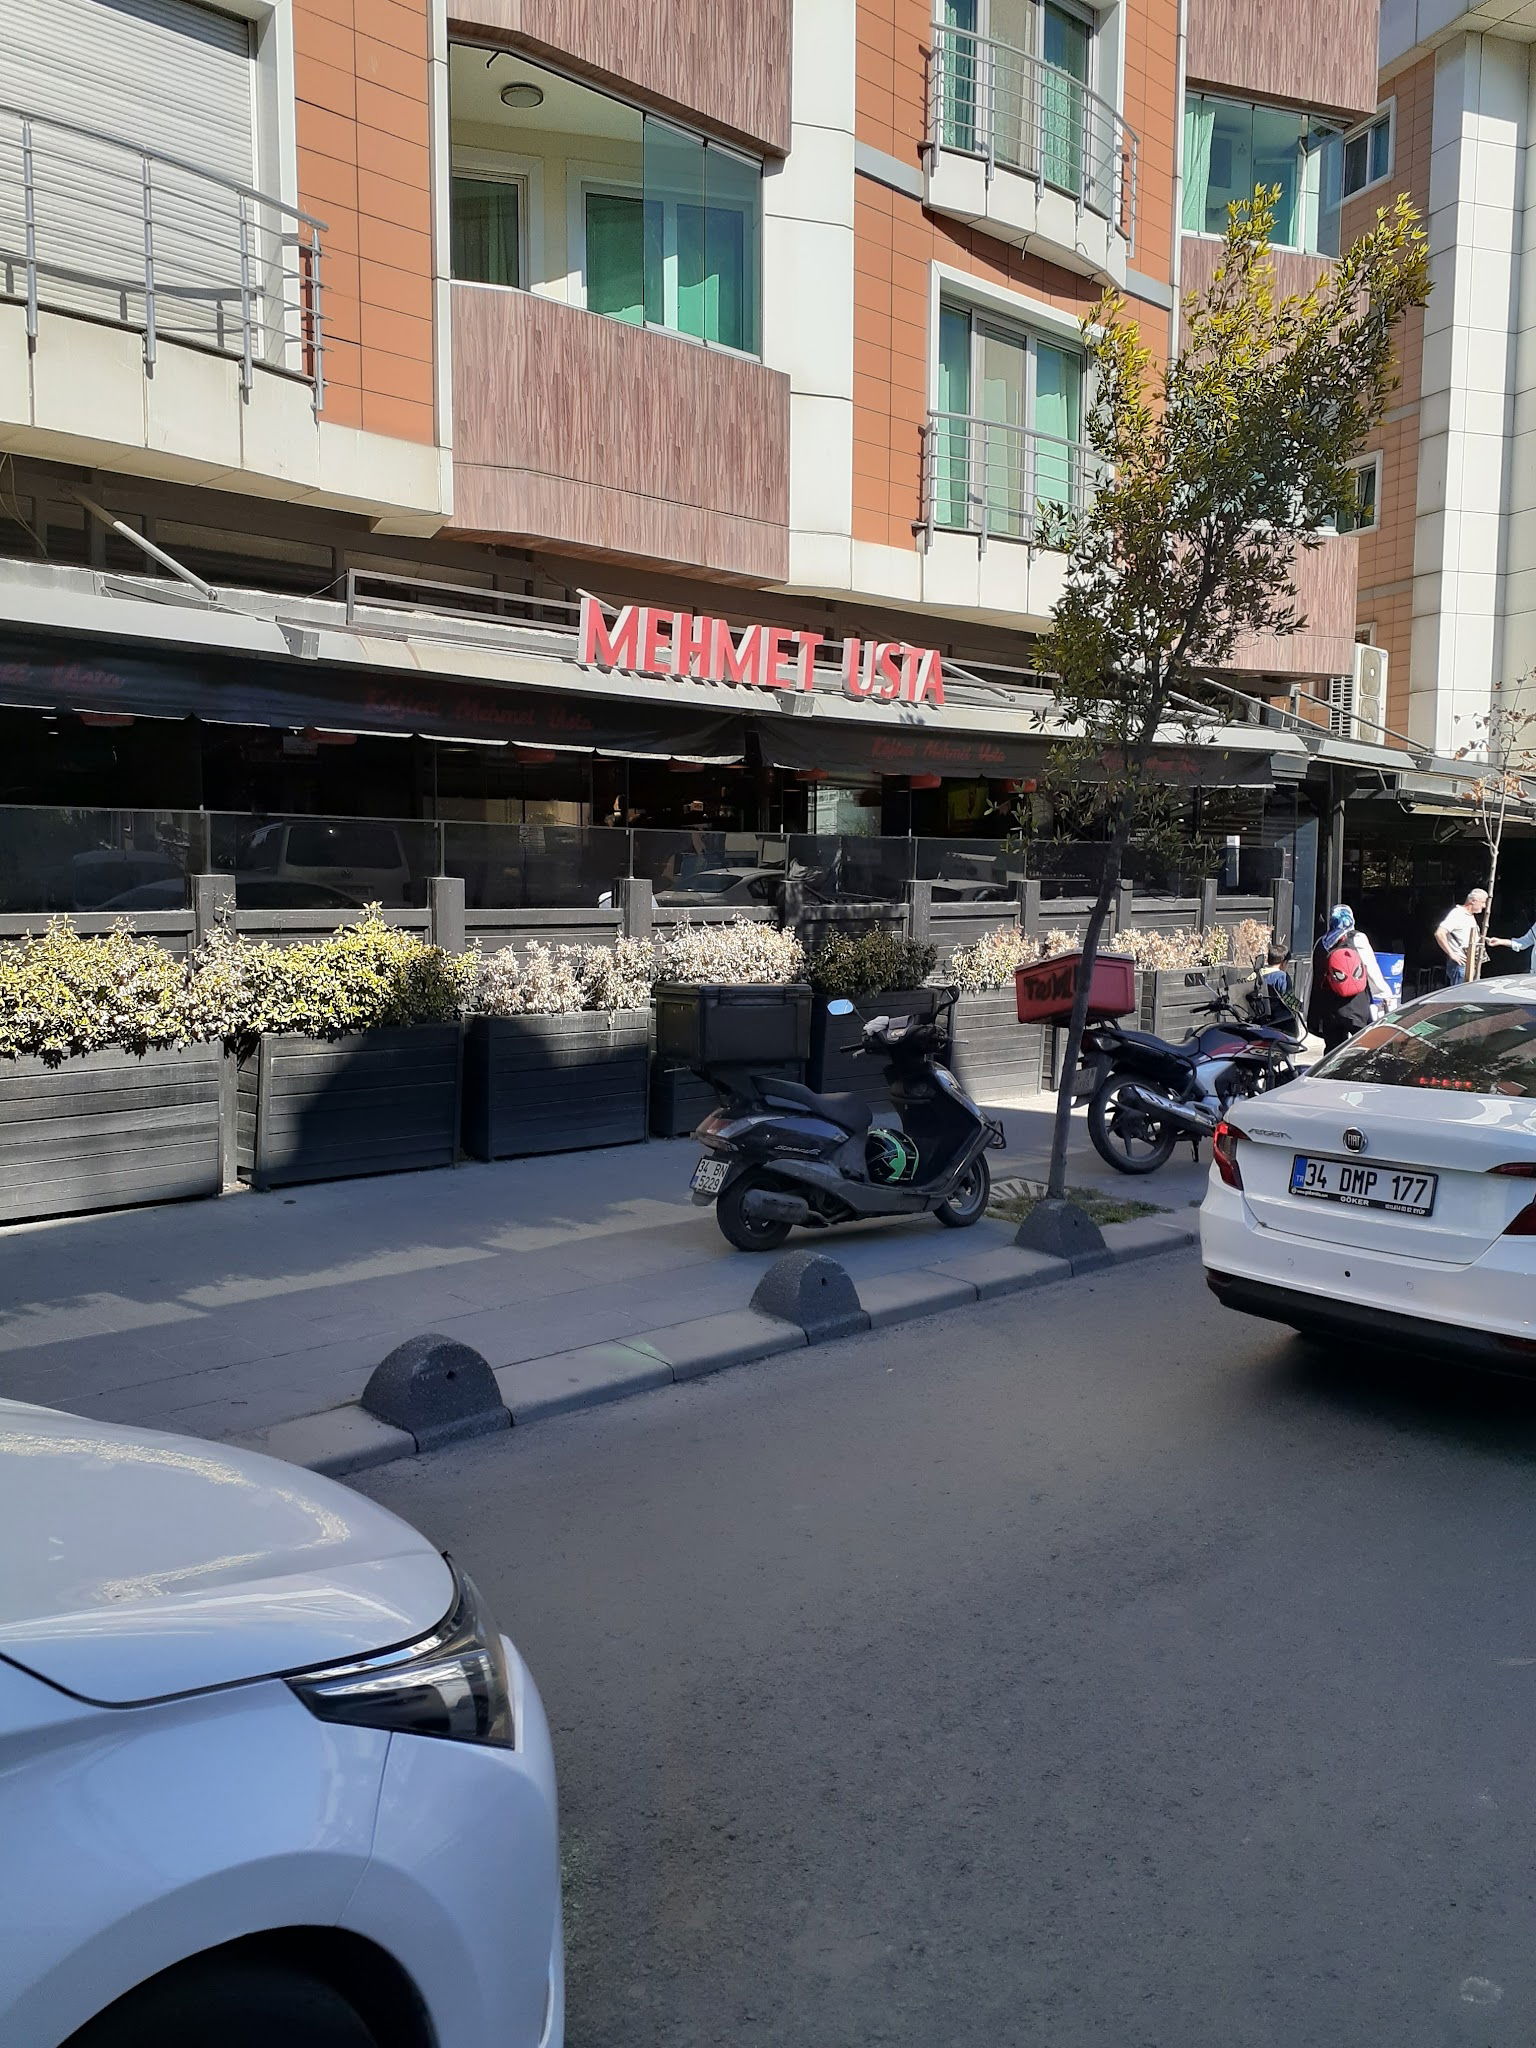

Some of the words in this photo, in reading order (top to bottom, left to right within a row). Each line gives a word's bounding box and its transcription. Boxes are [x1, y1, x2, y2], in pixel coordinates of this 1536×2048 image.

[579, 597, 824, 691] MEHMET
[842, 637, 945, 705] USTA
[1347, 1134, 1361, 1147] FIAT
[698, 1160, 710, 1174] 34
[714, 1163, 728, 1178] BN
[698, 1175, 720, 1190] 5229
[1305, 1163, 1328, 1189] 34
[1339, 1167, 1378, 1196] DMP
[1392, 1175, 1428, 1203] 177
[1340, 1195, 1369, 1207] GÖKER
